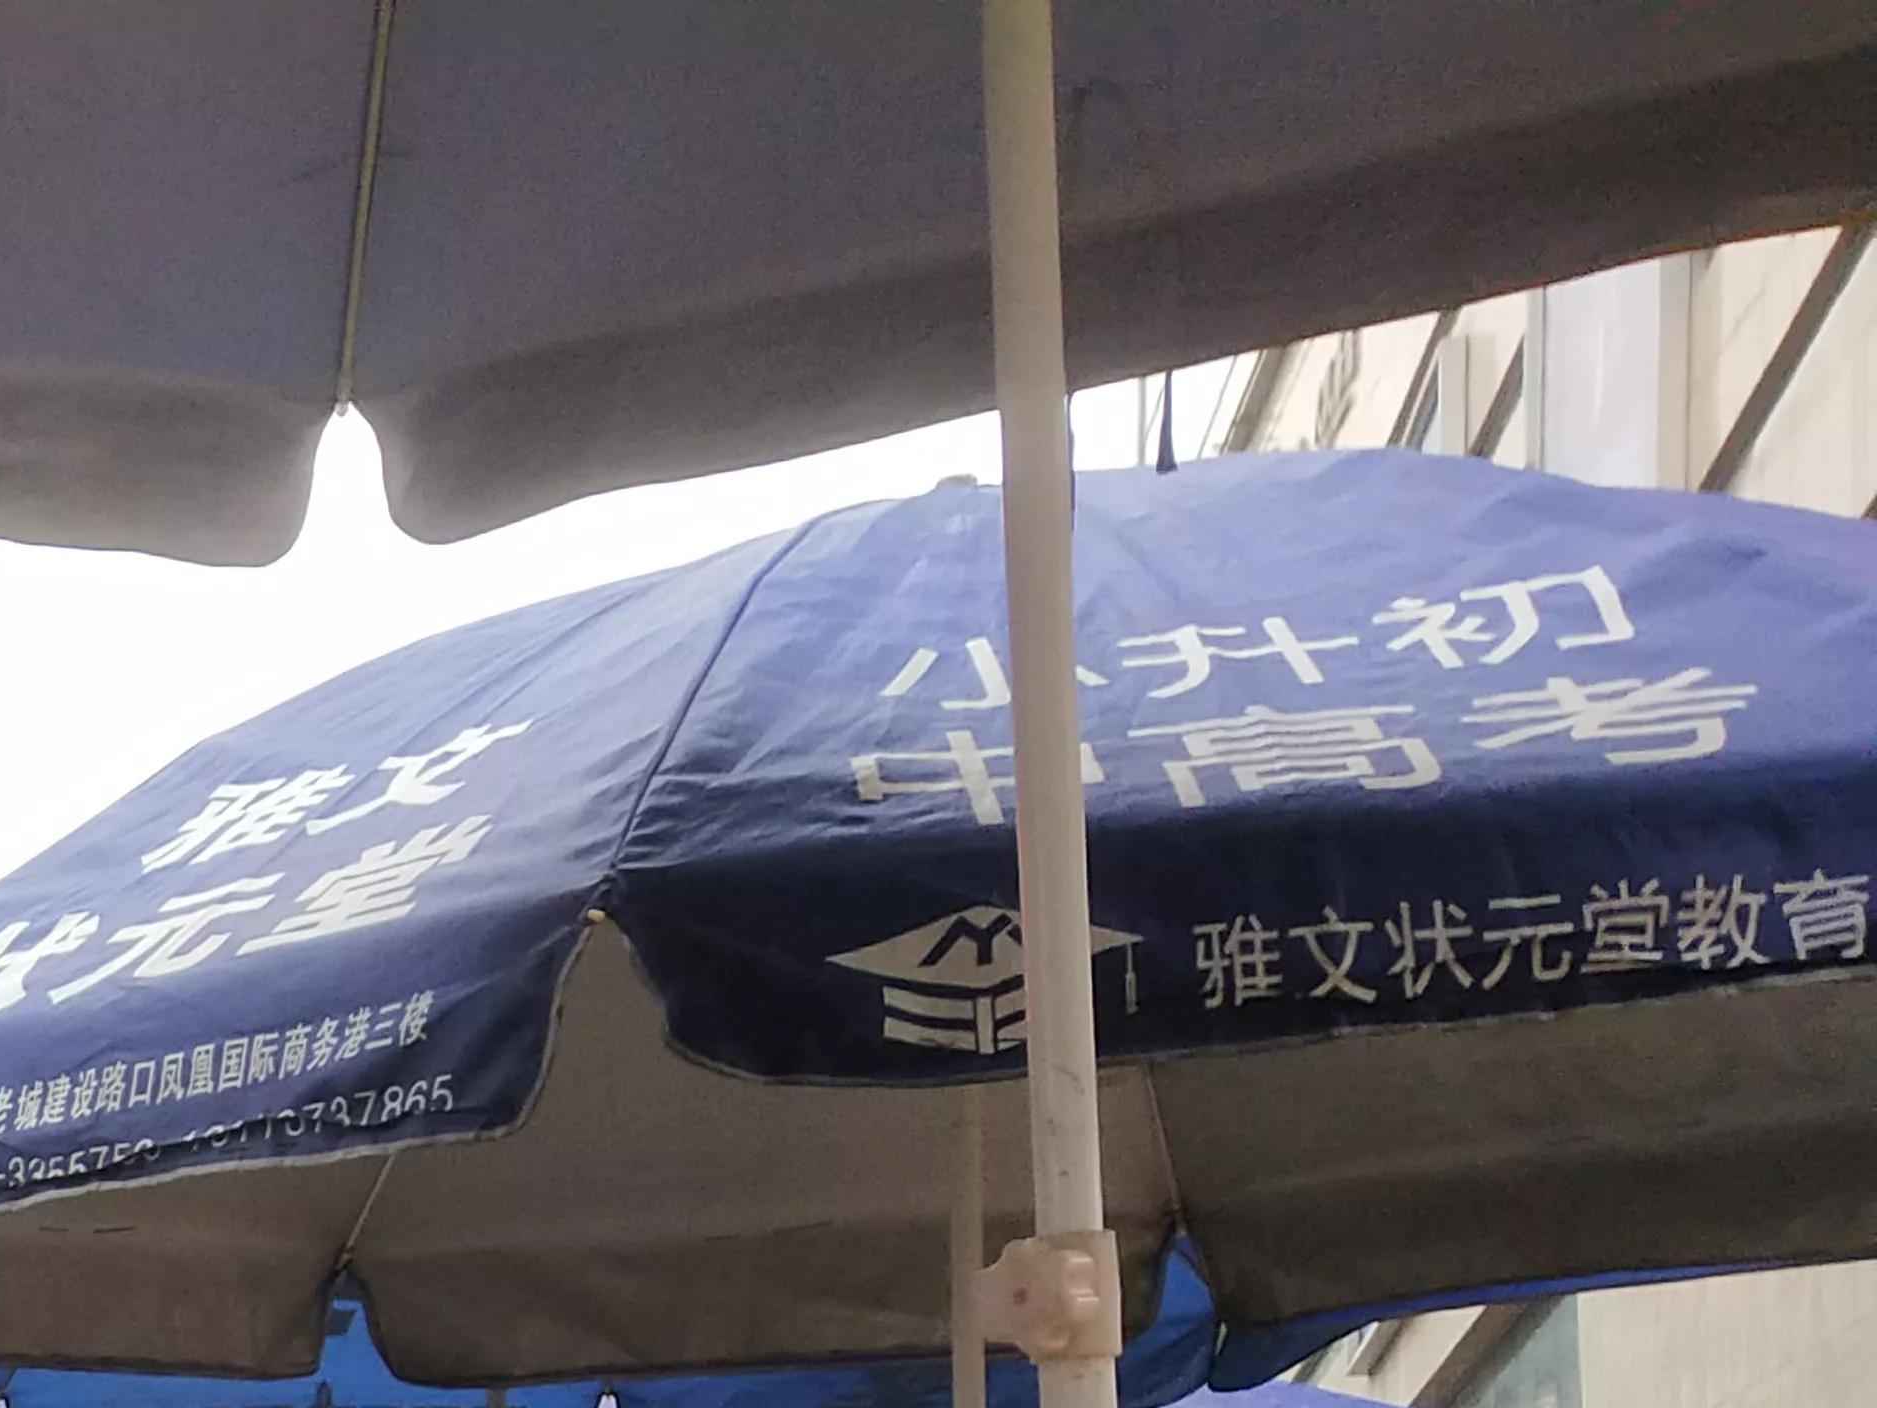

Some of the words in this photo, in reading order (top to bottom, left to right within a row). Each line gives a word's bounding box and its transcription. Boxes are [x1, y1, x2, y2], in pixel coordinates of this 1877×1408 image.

[880, 566, 1636, 708] 小升初
[142, 719, 536, 874] 雅文
[848, 668, 1758, 824] 中高考
[1193, 867, 1871, 1010] 雅文状元堂教育
